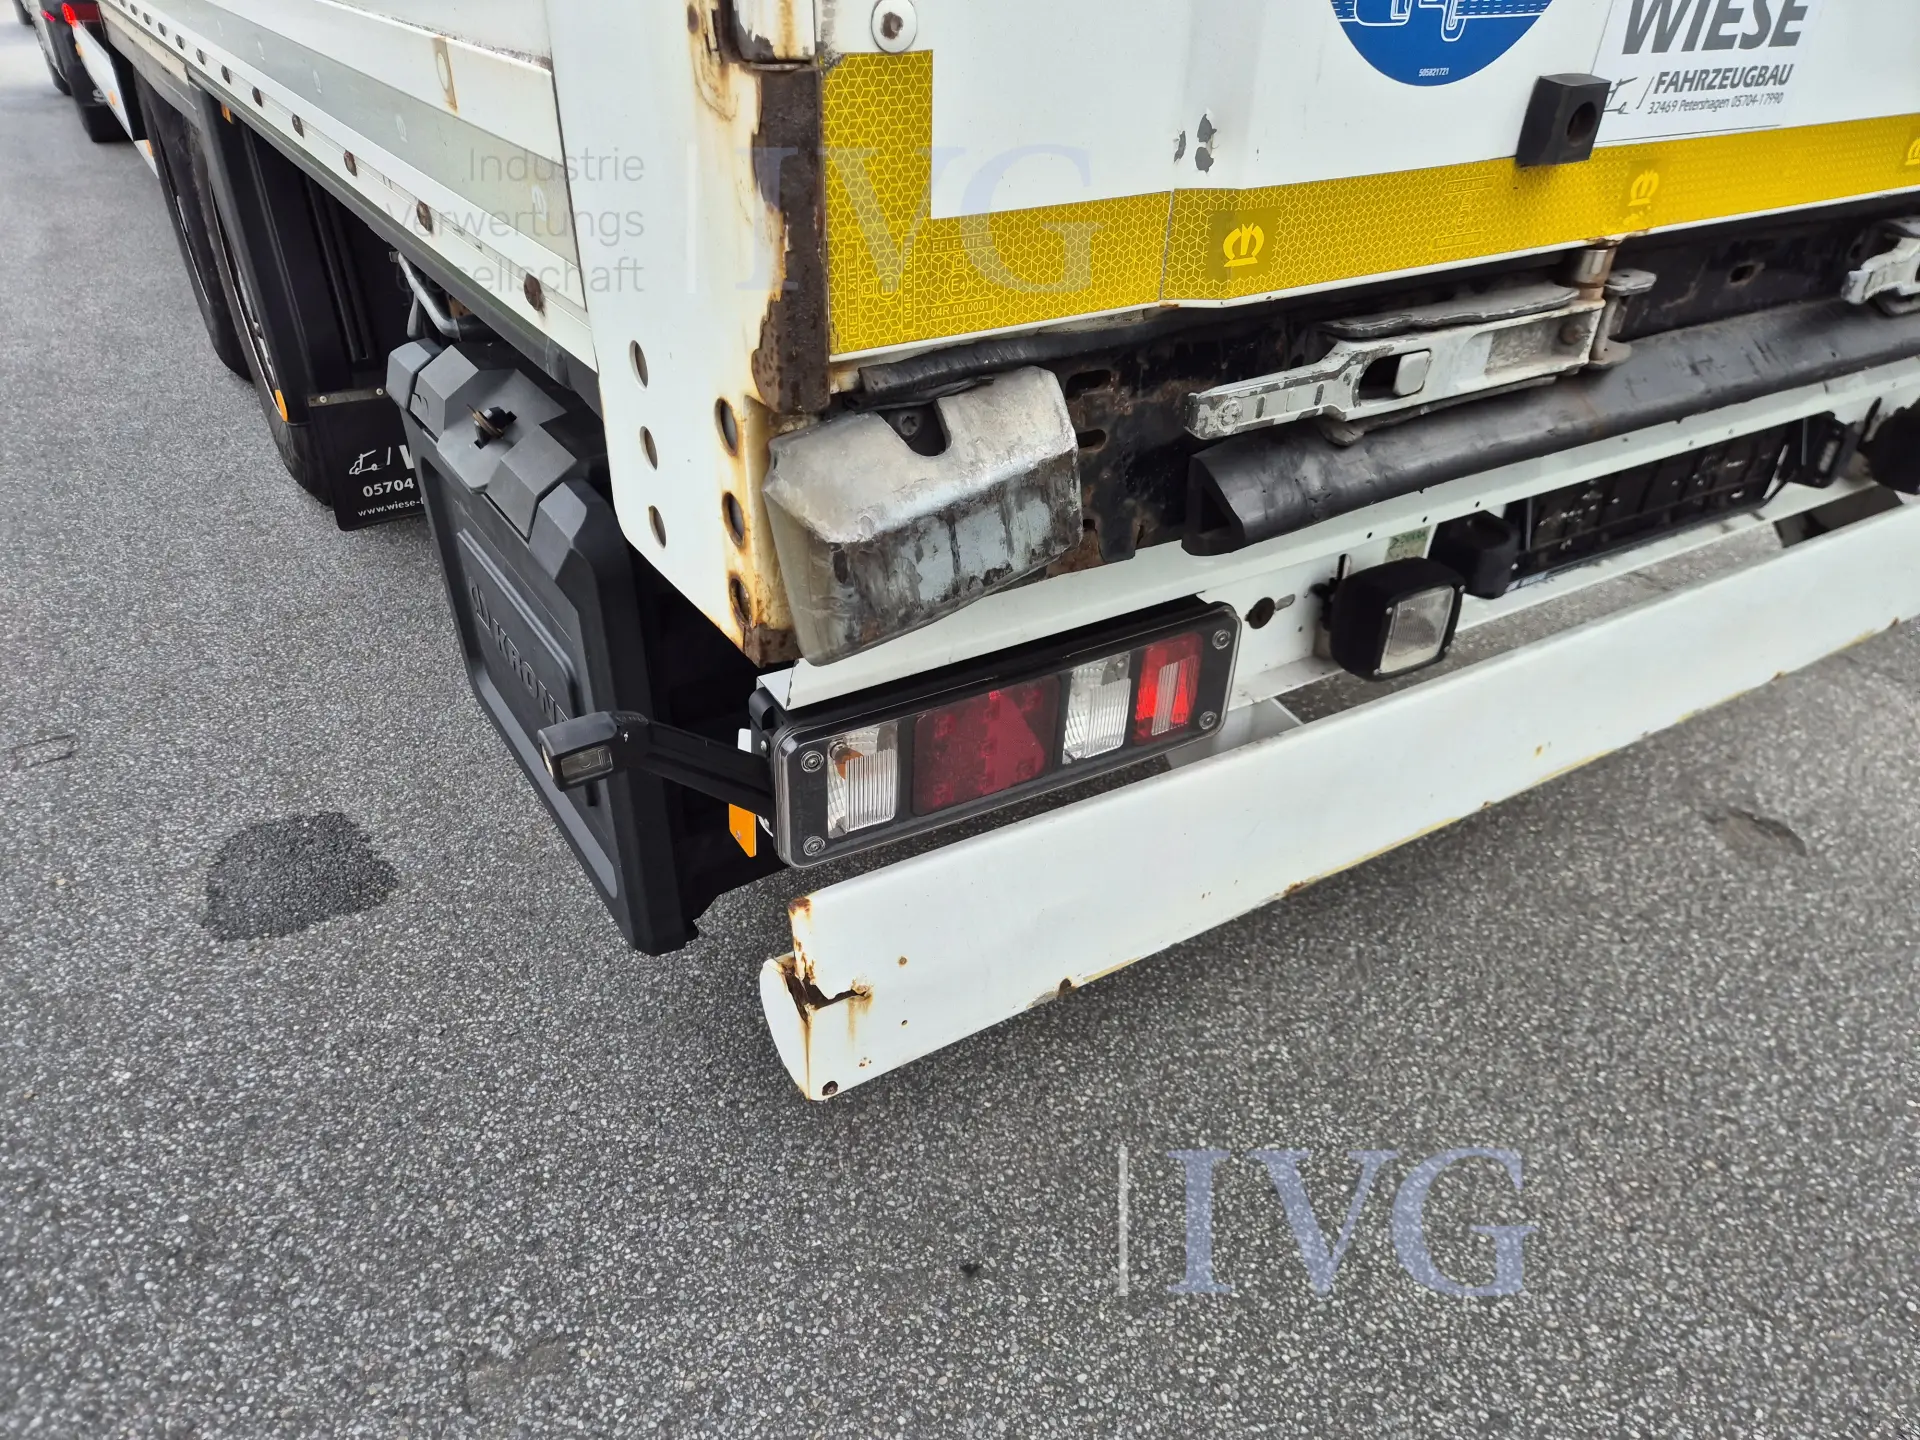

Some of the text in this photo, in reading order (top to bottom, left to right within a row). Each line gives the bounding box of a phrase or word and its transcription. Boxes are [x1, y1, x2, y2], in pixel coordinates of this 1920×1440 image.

[1622, 0, 1809, 55] WIESE
[1653, 63, 1795, 95] FAHRZEUGBAU
[1647, 92, 1785, 115] 32469 Petershagen 05704-17990
[951, 277, 965, 292] E4
[362, 478, 415, 498] 05704
